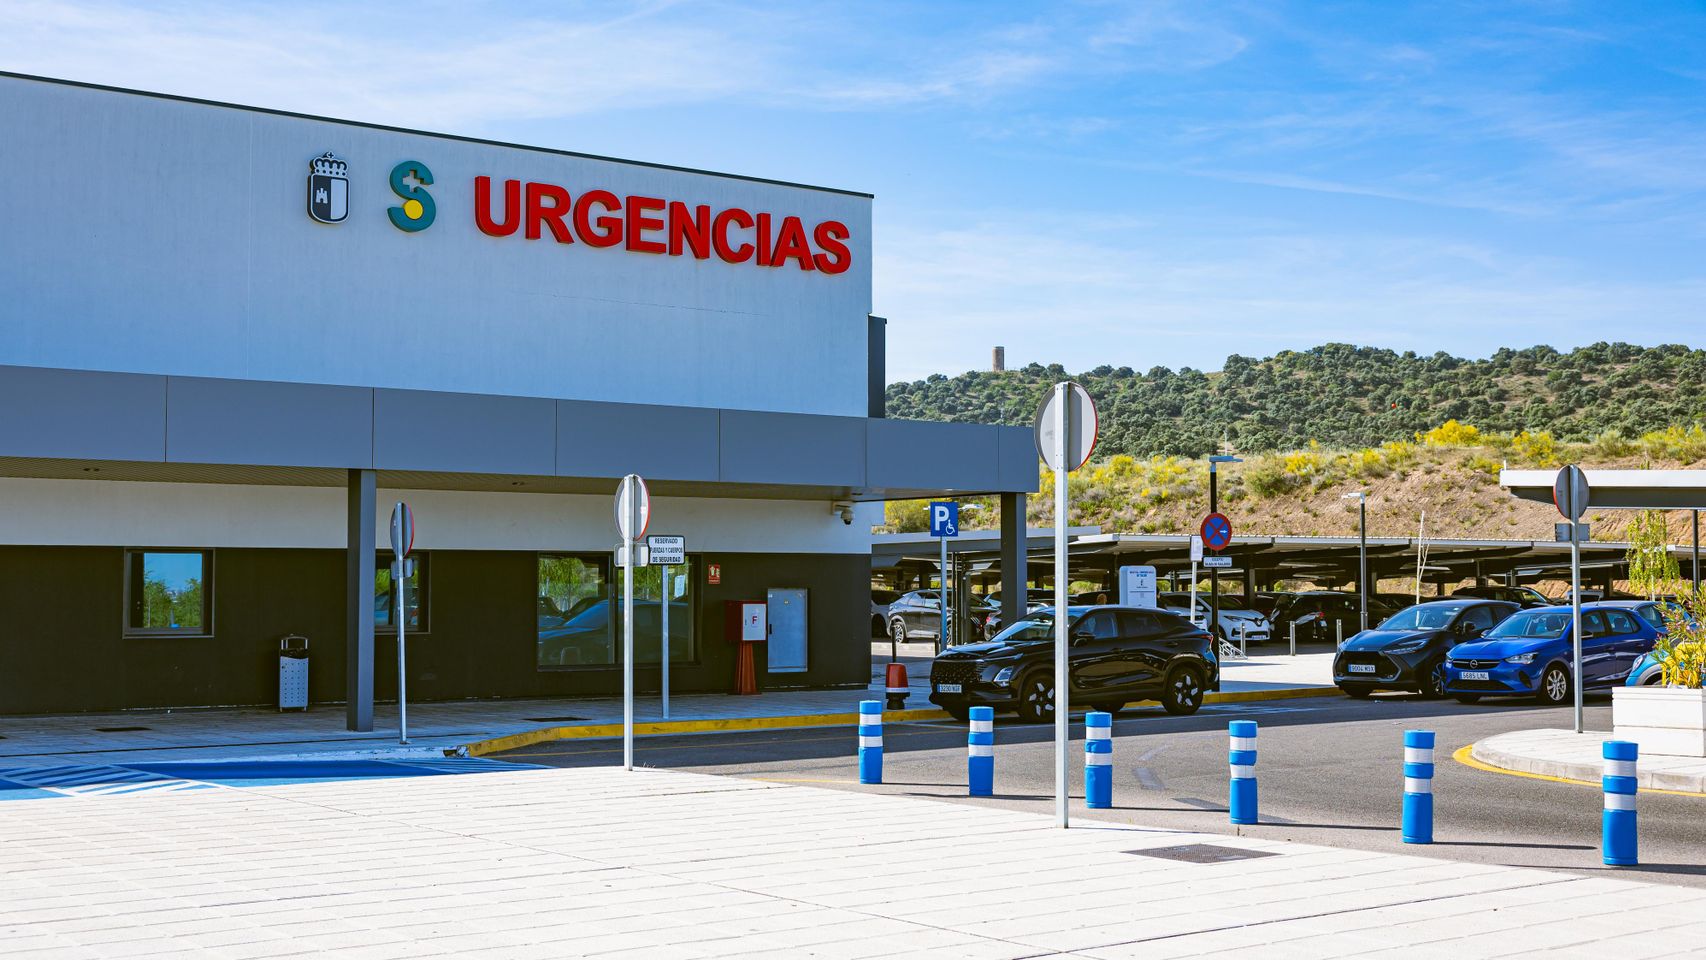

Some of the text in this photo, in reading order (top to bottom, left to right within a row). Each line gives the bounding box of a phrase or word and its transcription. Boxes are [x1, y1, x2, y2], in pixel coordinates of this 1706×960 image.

[474, 175, 852, 275] URGENCIAS
[935, 506, 949, 531] P
[752, 616, 758, 624] F
